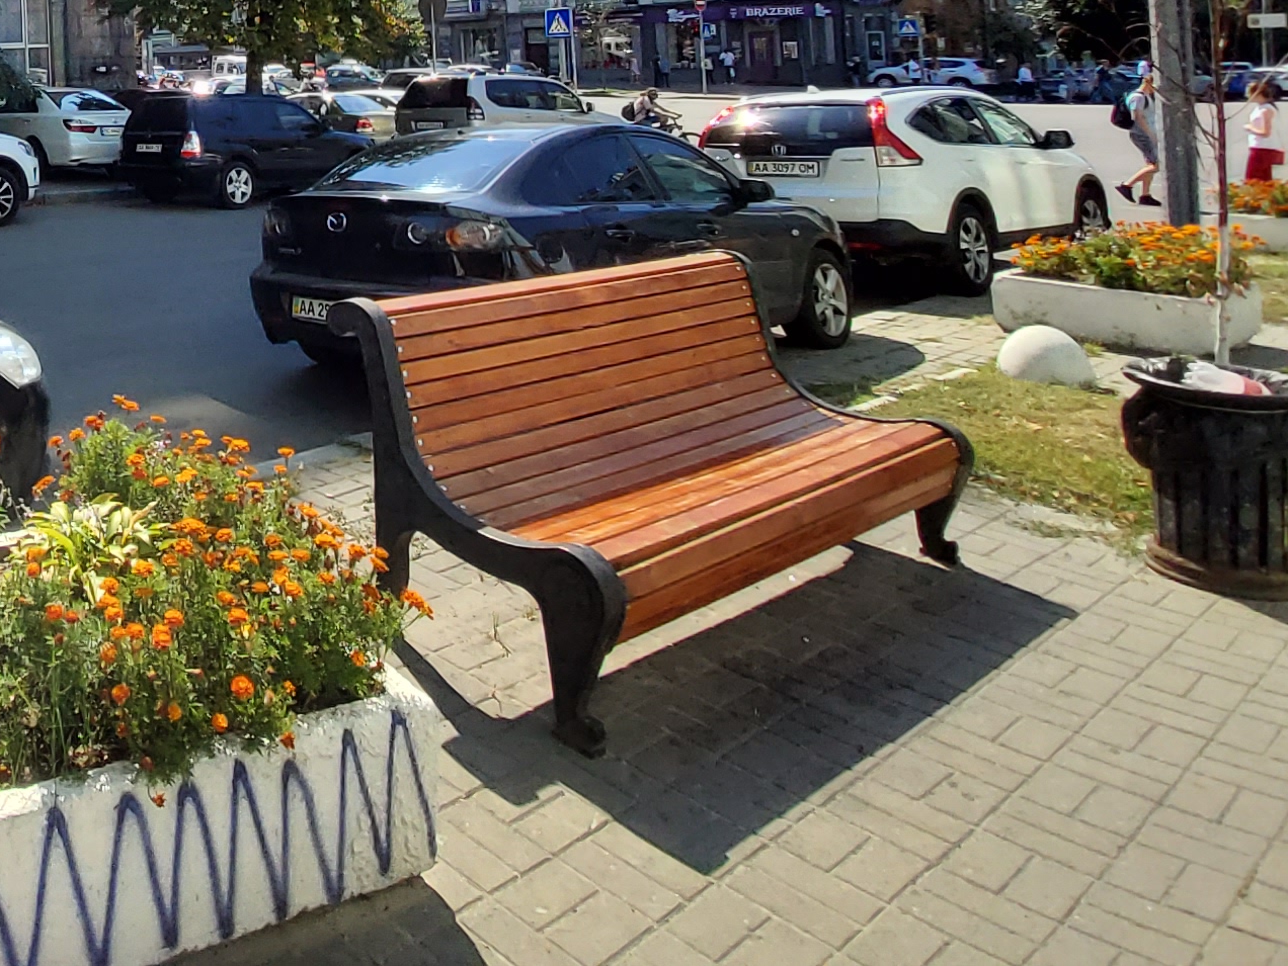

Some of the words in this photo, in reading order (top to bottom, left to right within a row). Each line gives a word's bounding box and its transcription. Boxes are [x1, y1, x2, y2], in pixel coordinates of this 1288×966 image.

[745, 6, 805, 17] BRAZERIE
[754, 163, 769, 173] AA
[772, 163, 795, 173] 3097
[299, 299, 316, 317] AA
